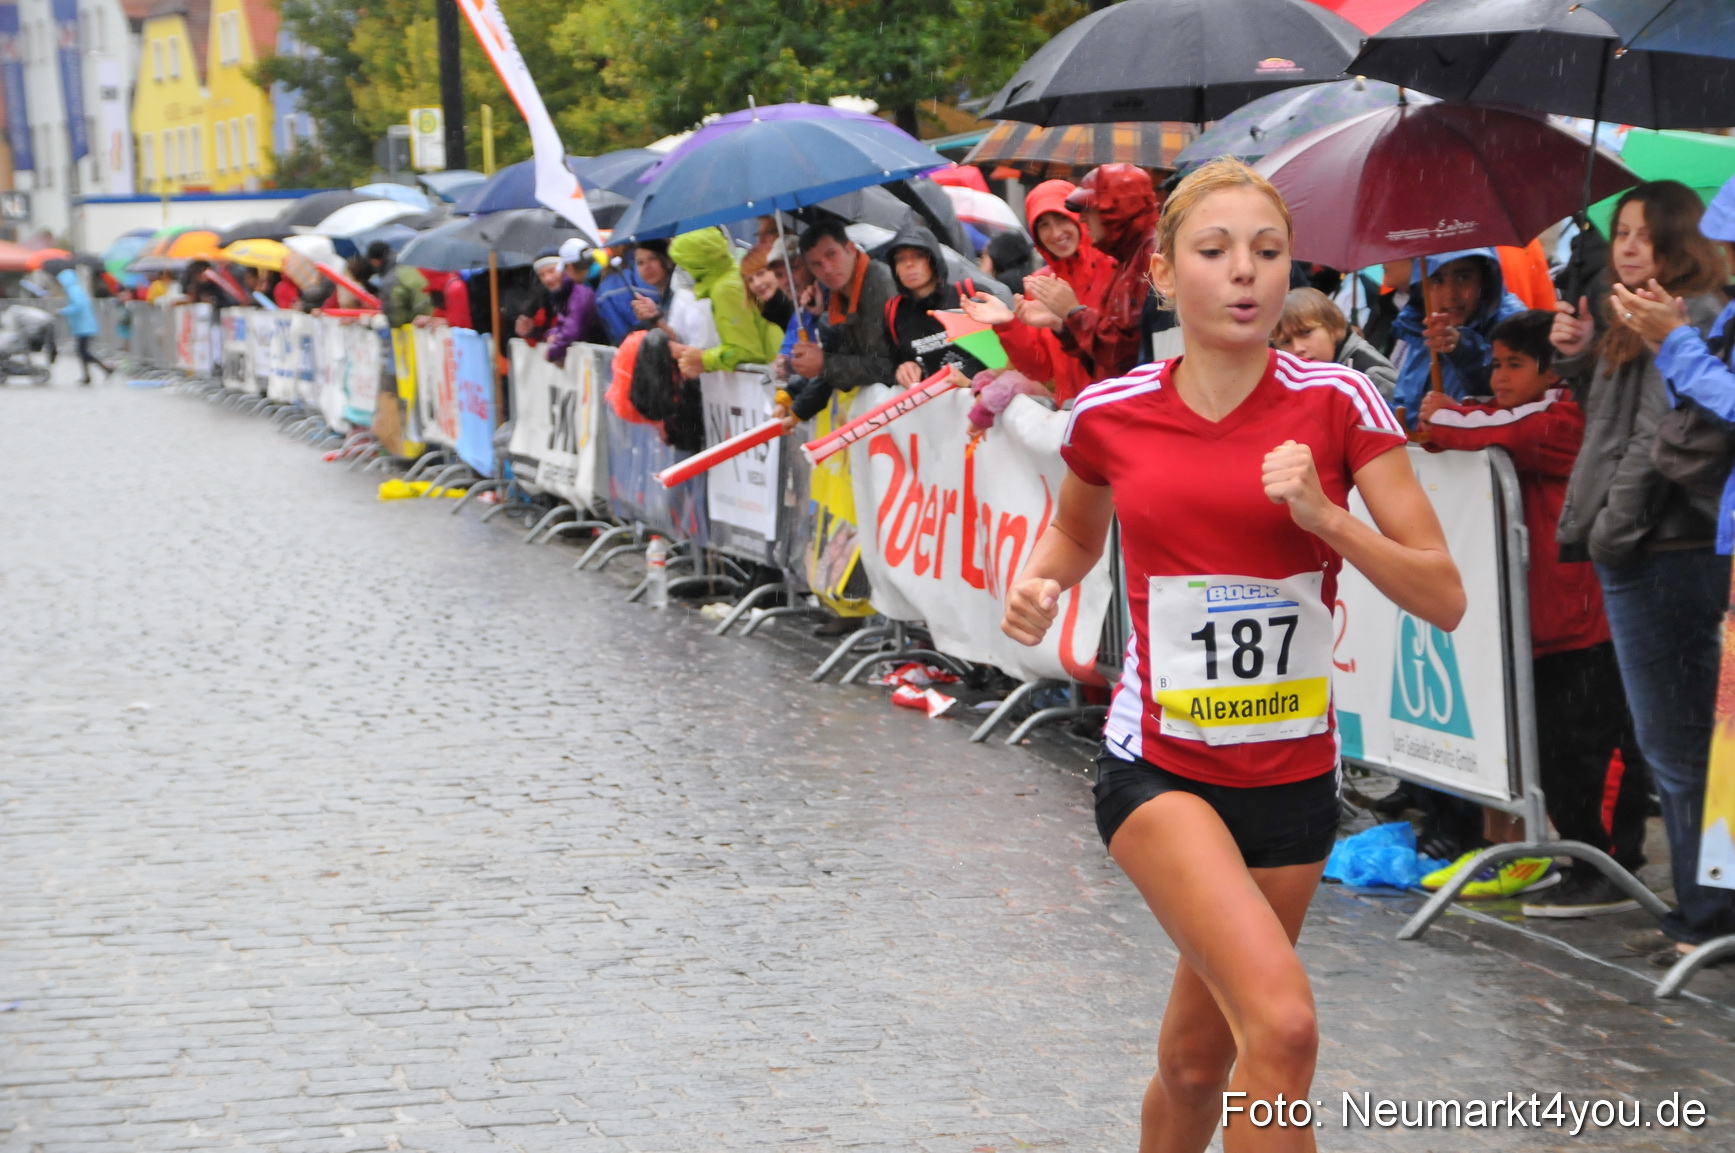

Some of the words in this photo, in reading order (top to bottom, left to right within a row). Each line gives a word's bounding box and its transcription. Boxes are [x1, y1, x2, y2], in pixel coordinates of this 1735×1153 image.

[838, 389, 933, 446] AUSTRIA
[1207, 584, 1280, 603] BOCK
[1191, 614, 1299, 680] 187
[1160, 677, 1168, 689] B
[1190, 691, 1300, 721] Alexandra
